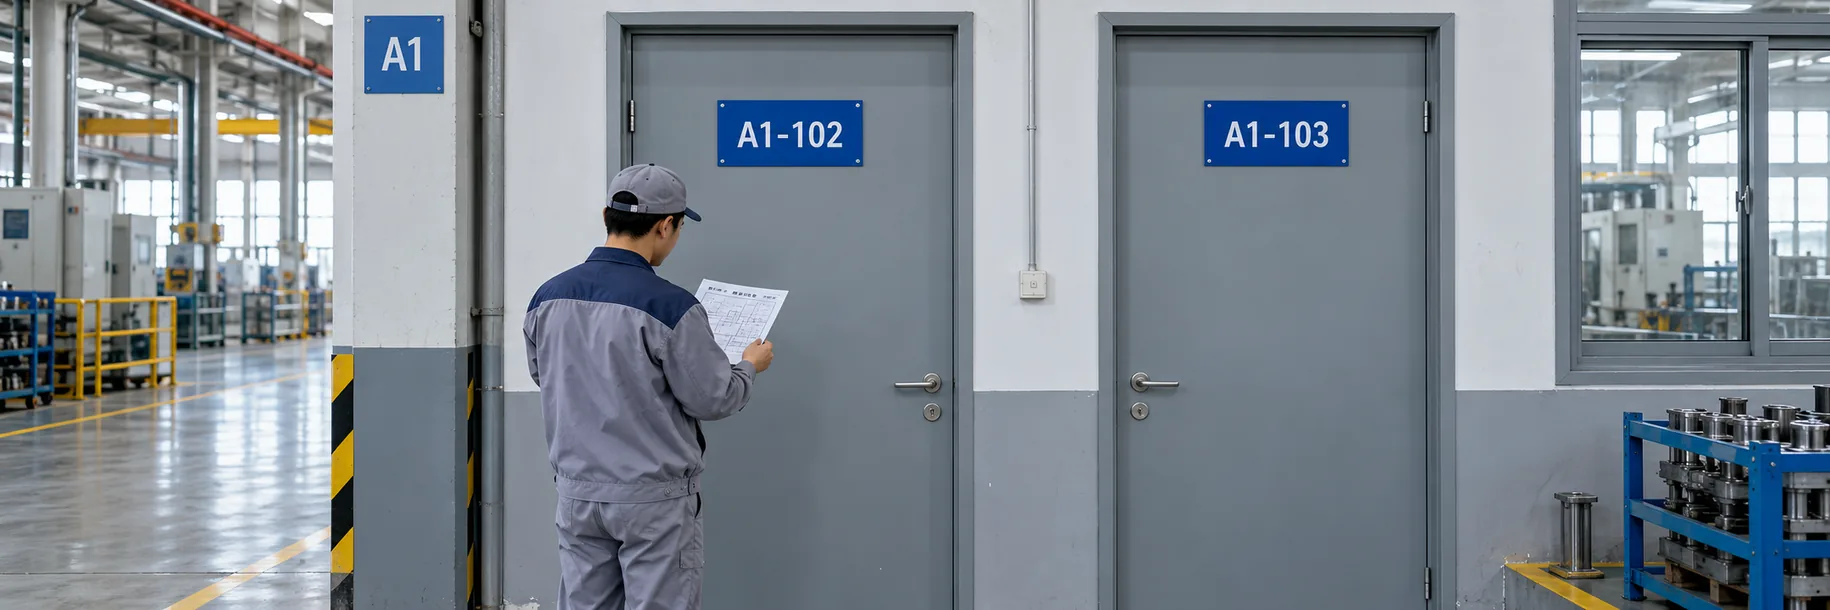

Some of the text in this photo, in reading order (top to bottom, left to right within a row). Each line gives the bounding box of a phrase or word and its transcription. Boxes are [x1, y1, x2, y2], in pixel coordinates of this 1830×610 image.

[381, 36, 421, 72] A1
[737, 121, 843, 148] A1-102
[1224, 120, 1329, 148] A1-103
